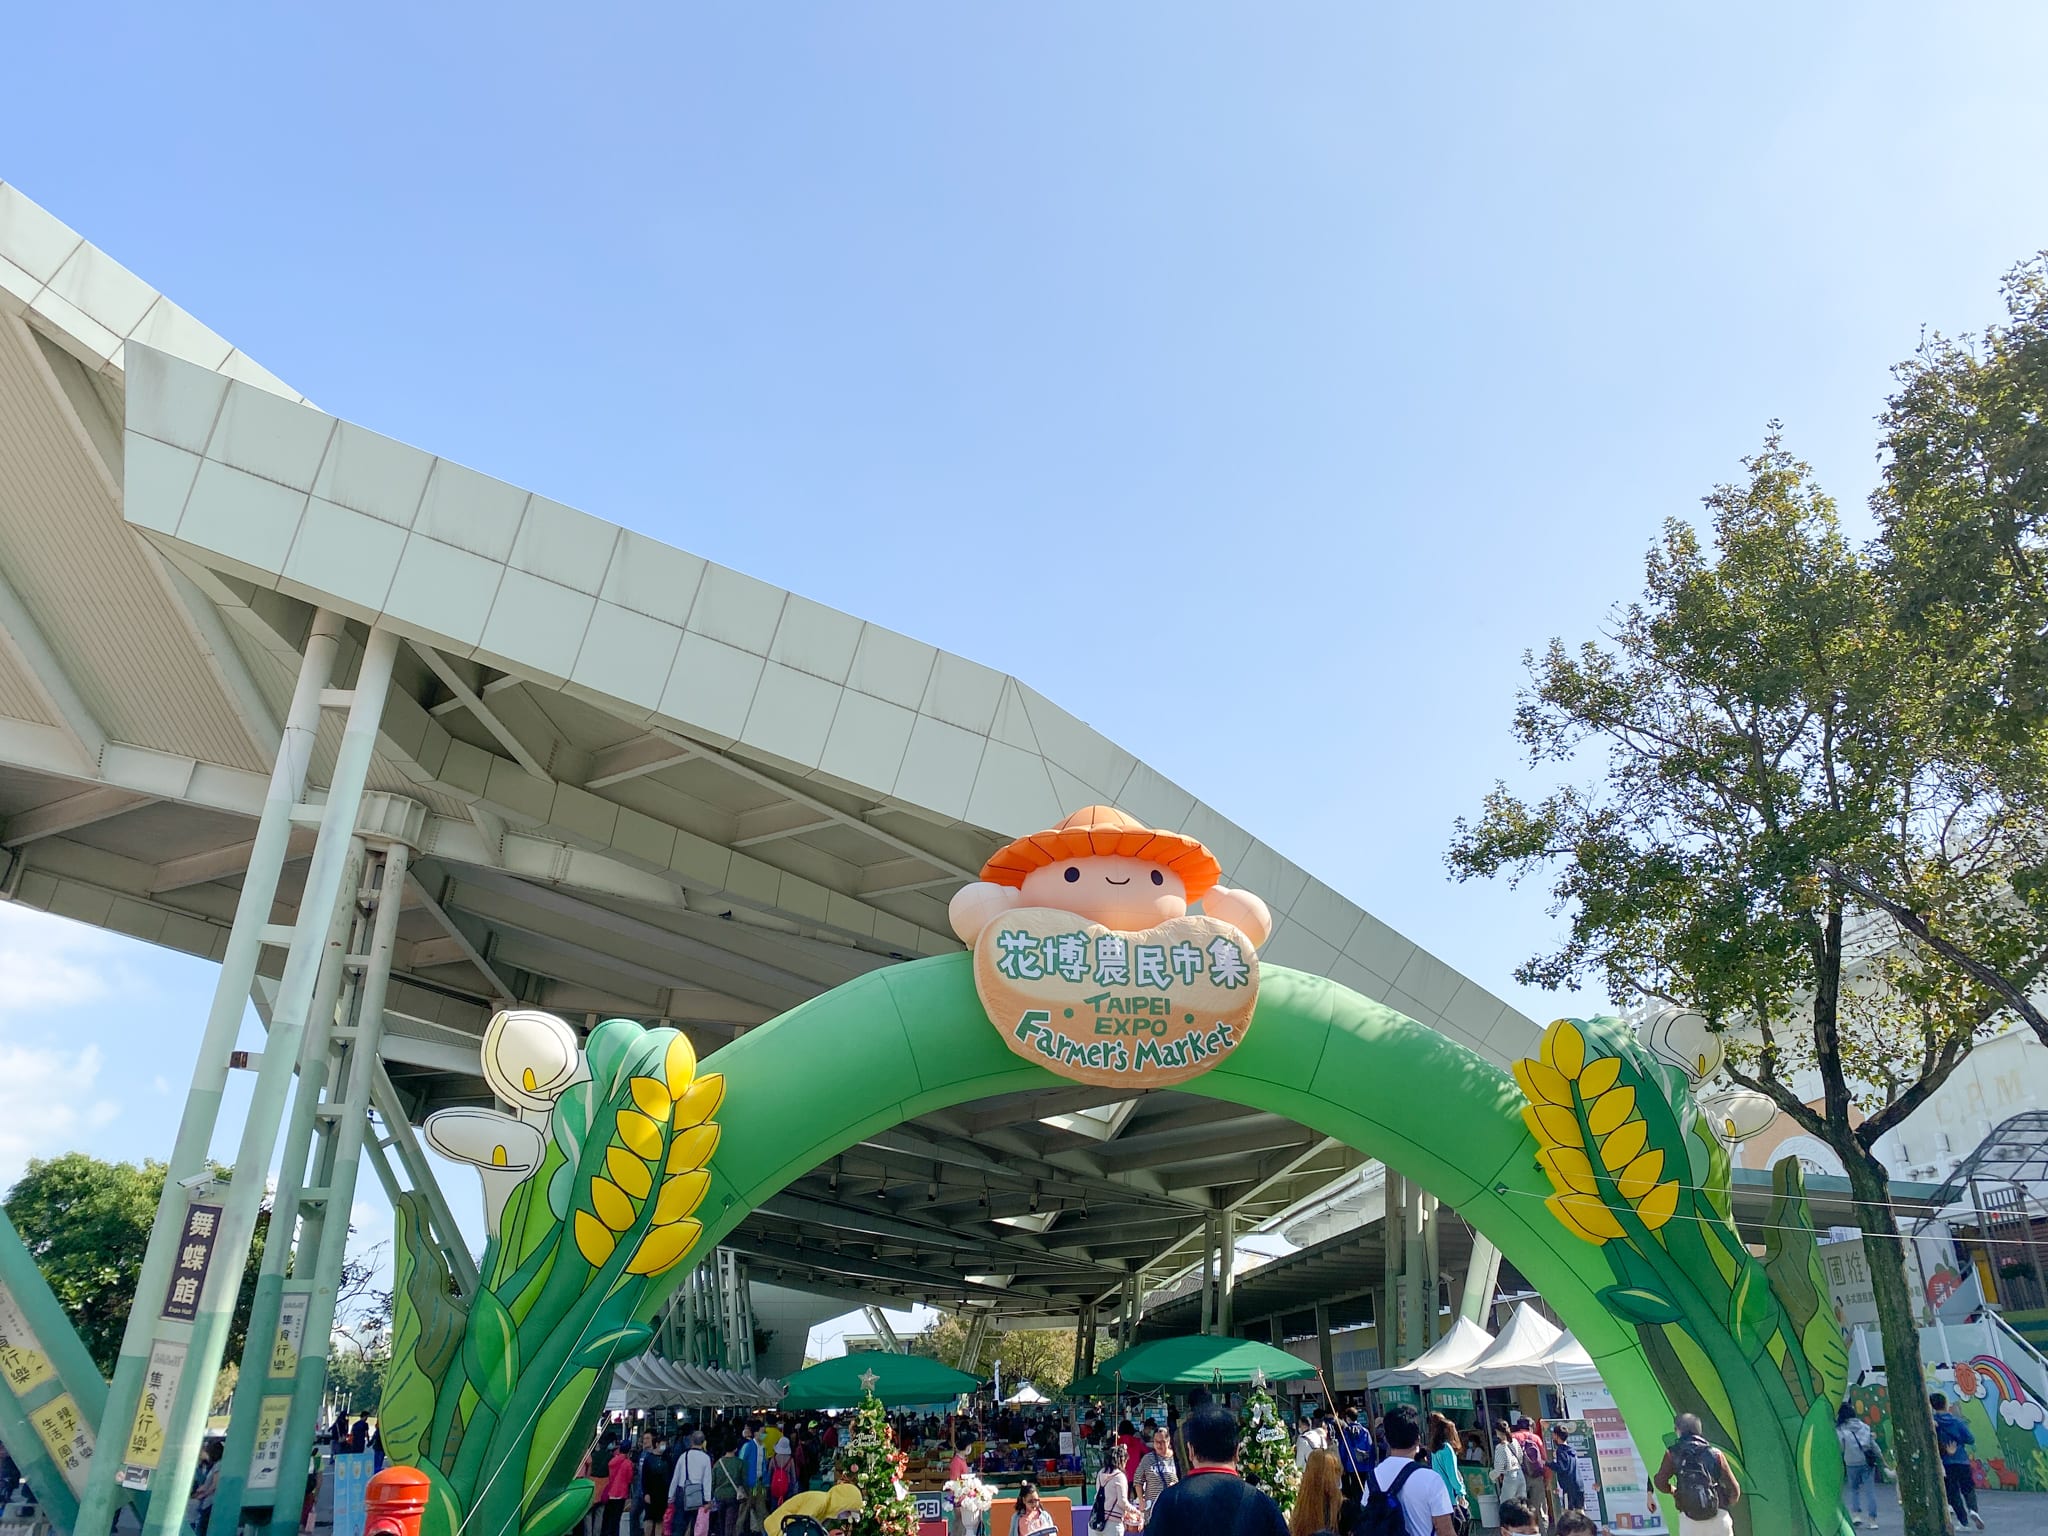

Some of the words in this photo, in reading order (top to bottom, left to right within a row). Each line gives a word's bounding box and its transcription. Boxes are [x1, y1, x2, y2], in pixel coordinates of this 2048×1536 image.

[998, 930, 1249, 990] 花博農民市集
[1083, 992, 1171, 1016] TAIPEI
[1094, 1017, 1168, 1037] EXPO
[1014, 1010, 1129, 1072] Farmer's
[1133, 1021, 1235, 1072] Market
[172, 1210, 215, 1305] 舞蝶館
[132, 1370, 163, 1455] 集食行樂
[914, 1502, 938, 1516] PEI
